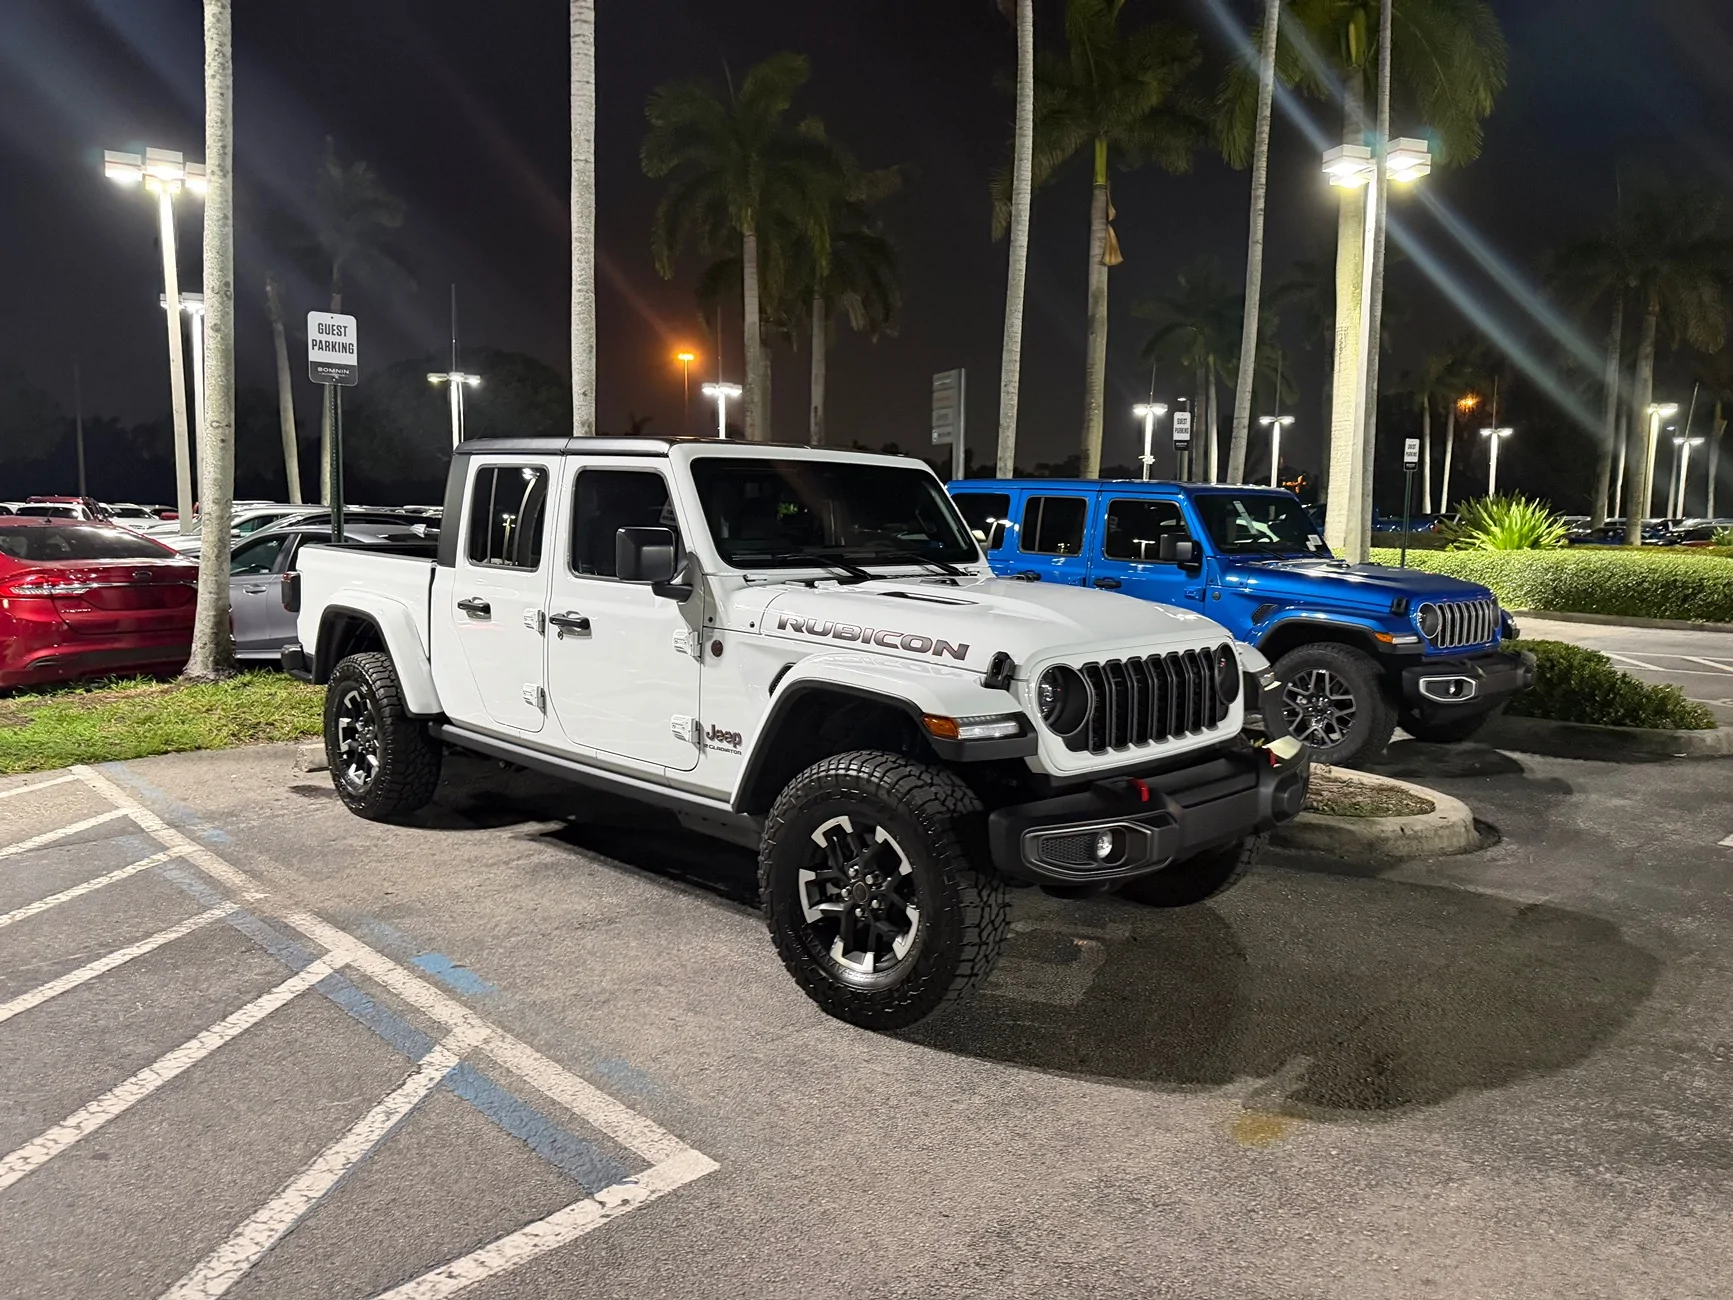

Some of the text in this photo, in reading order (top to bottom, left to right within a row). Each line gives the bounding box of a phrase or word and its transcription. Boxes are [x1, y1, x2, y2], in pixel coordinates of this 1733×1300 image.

[317, 322, 348, 337] GUEST
[311, 338, 355, 355] PARKING
[317, 366, 350, 375] BOMNIN
[777, 614, 970, 662] RUBICON
[706, 724, 743, 749] Jeep
